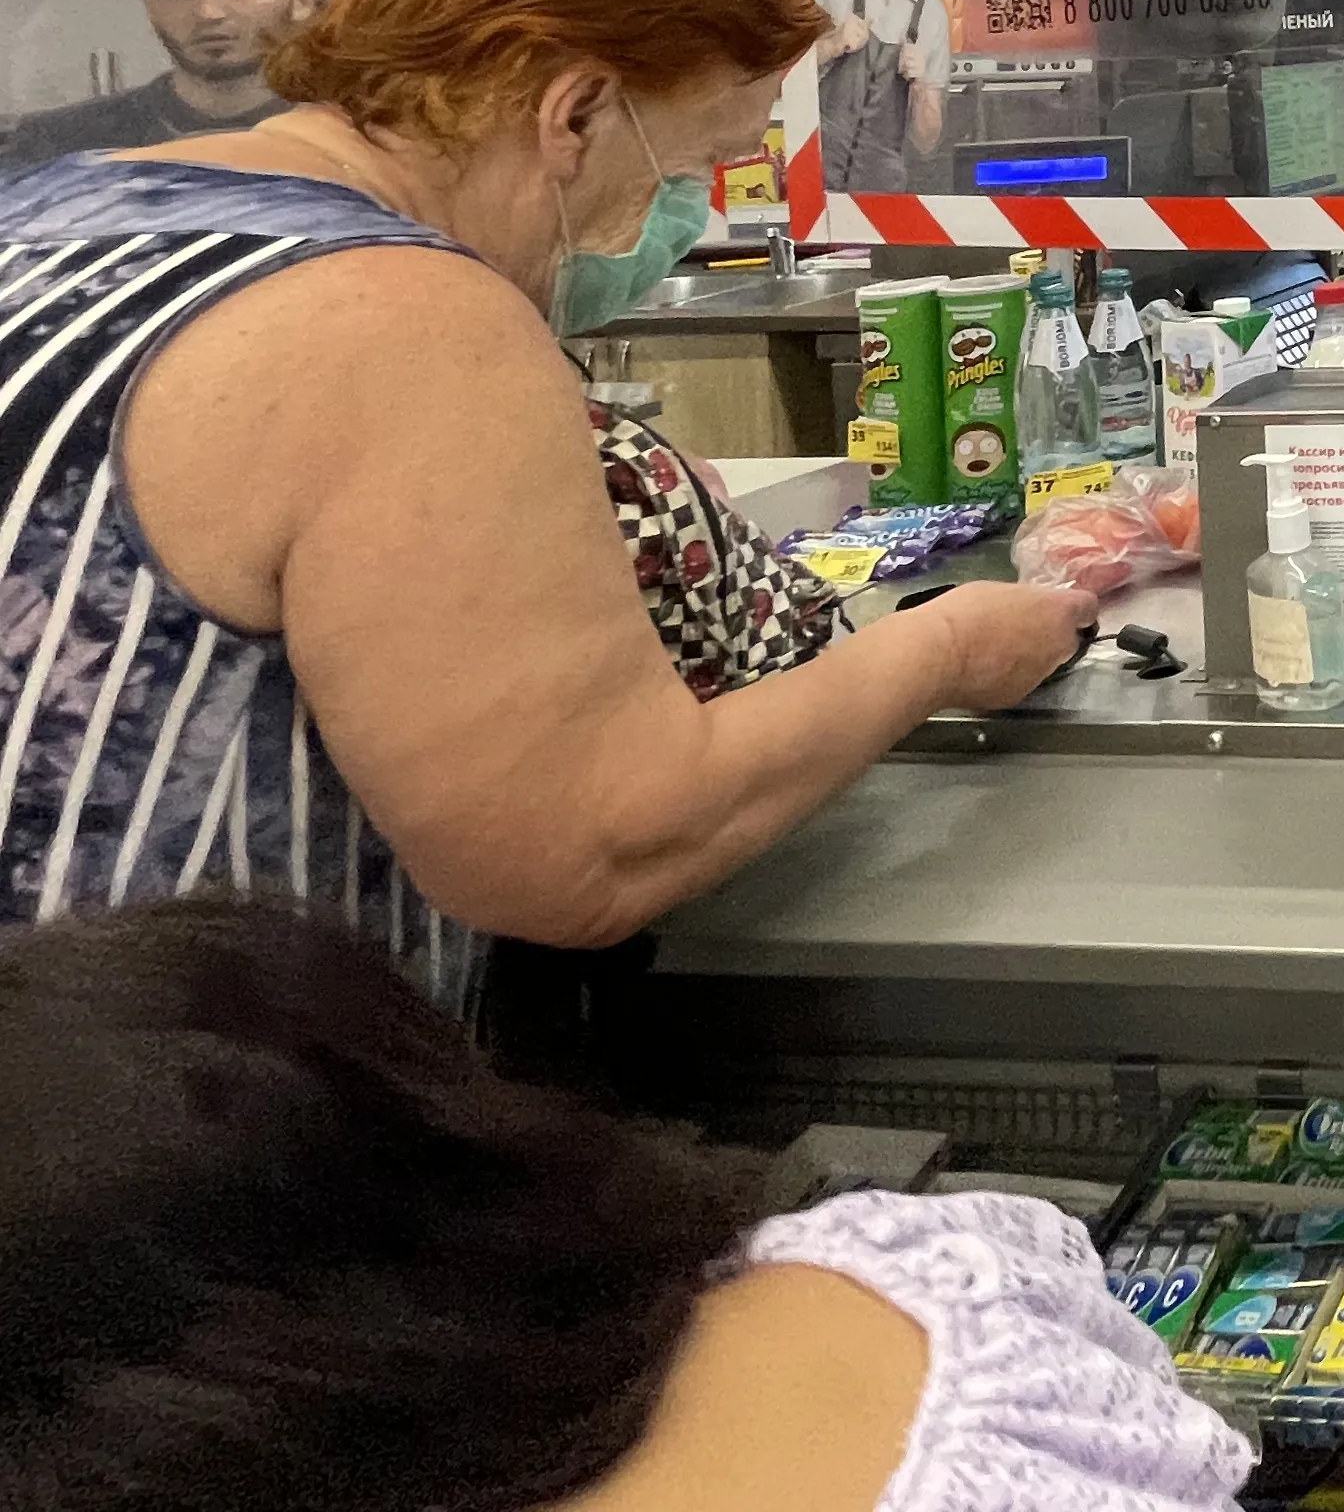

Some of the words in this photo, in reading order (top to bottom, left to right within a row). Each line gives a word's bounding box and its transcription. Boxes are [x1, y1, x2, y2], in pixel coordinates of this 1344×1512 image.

[1055, 319, 1071, 368] BORJOMI
[946, 356, 1005, 395] Pringles
[1289, 446, 1335, 459] Кассир
[1031, 479, 1054, 493] 37
